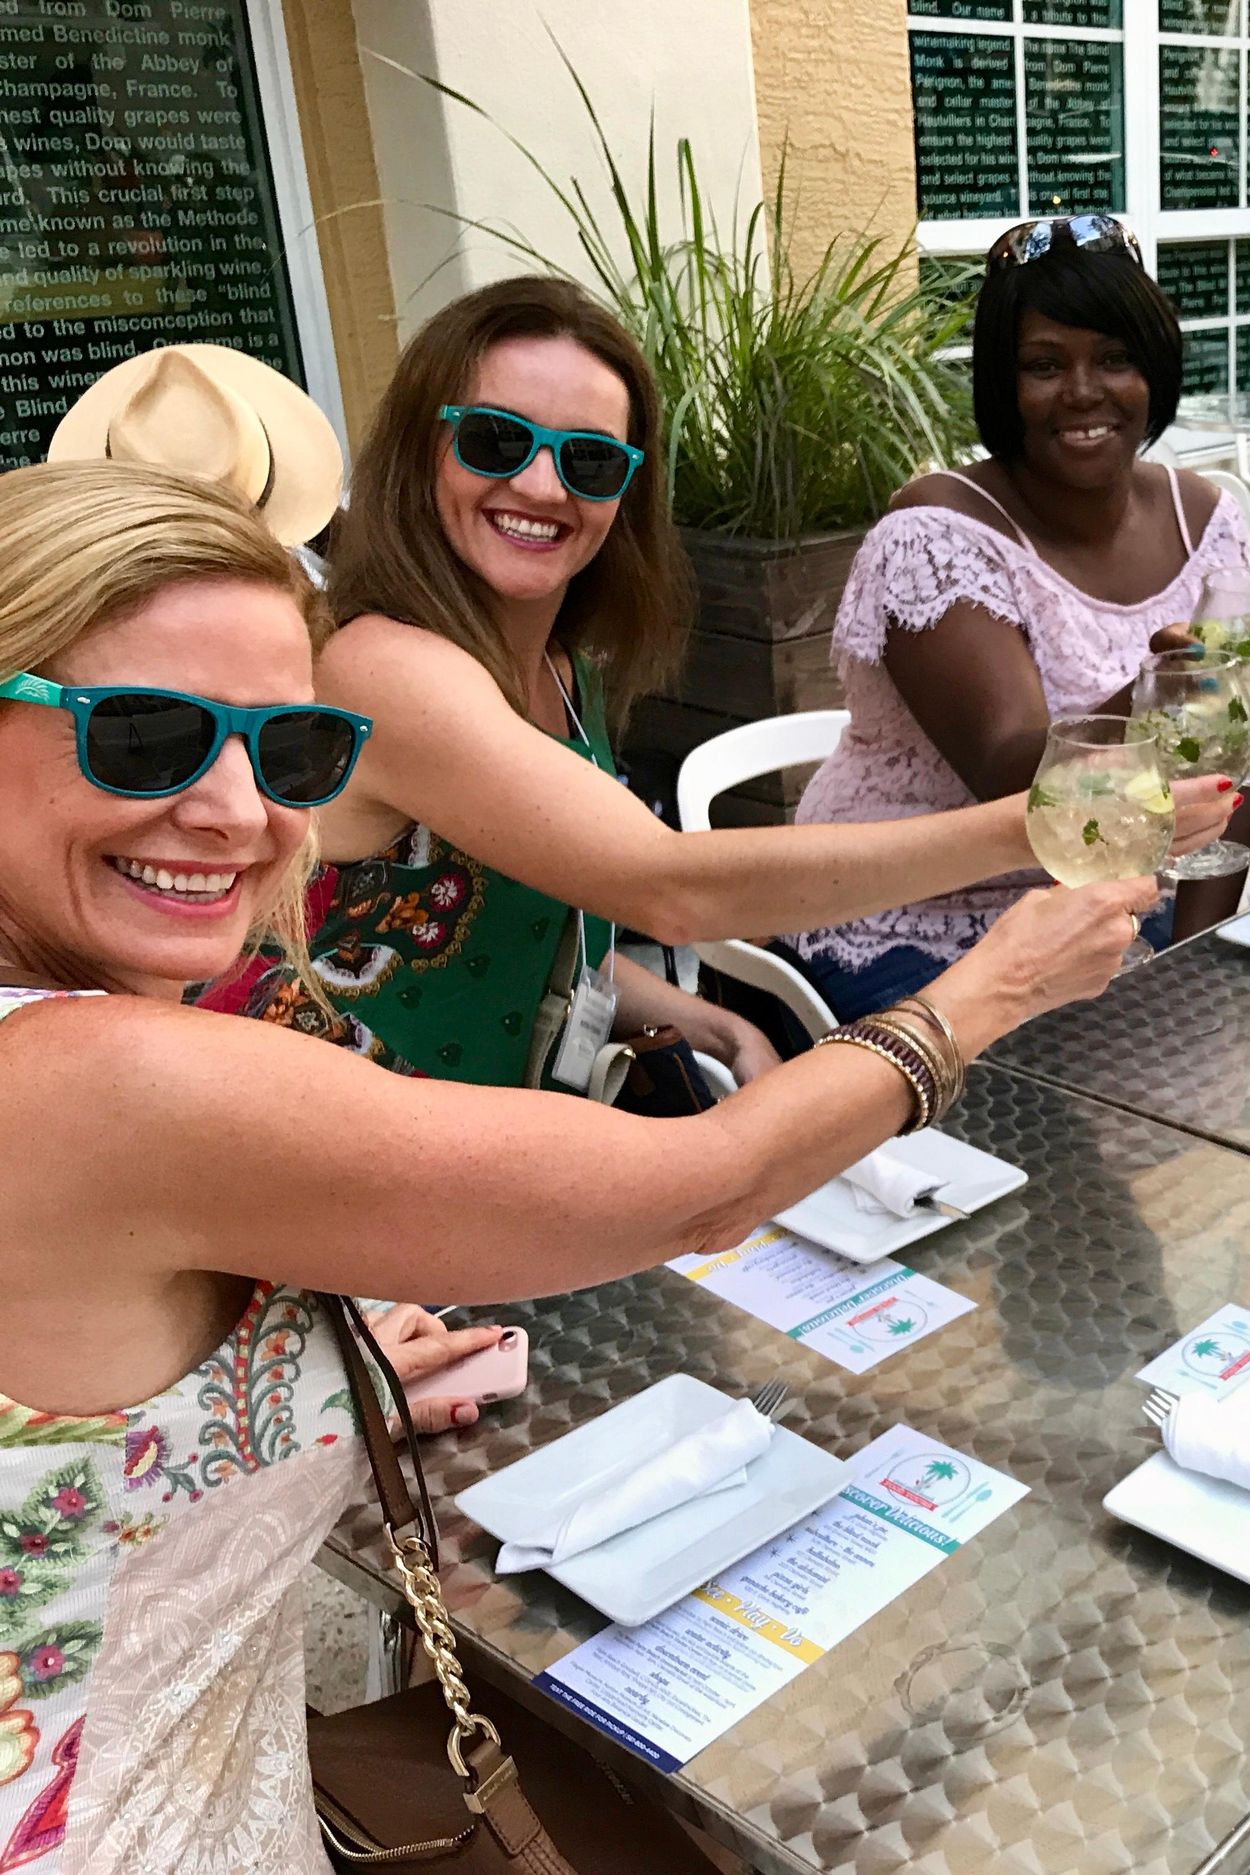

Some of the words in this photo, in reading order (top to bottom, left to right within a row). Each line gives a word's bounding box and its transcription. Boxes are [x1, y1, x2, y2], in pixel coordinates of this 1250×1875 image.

[40, 0, 86, 17] from
[106, 0, 152, 18] Dom
[171, 1, 227, 20] Pierre
[53, 25, 170, 45] Benedictine
[178, 29, 232, 47] monk
[0, 53, 37, 70] ster
[55, 52, 75, 70] of
[93, 53, 126, 71] the
[141, 54, 200, 76] Abbey
[216, 56, 234, 72] of
[126, 79, 198, 99] France.
[216, 81, 239, 99] To
[50, 107, 115, 128] quality
[124, 108, 190, 128] grapes
[197, 109, 242, 125] were
[14, 133, 80, 153] wines,
[85, 132, 131, 151] Dom
[138, 132, 195, 150] would
[200, 134, 247, 151] taste
[51, 159, 127, 178] without
[133, 159, 214, 180] knowing
[220, 160, 250, 177] the
[47, 187, 90, 206] This
[98, 184, 163, 204] crucial
[171, 184, 208, 201] first
[216, 186, 255, 205] step
[39, 213, 105, 234] known
[112, 213, 135, 229] as
[141, 211, 172, 228] the
[178, 209, 259, 227] Methode
[18, 240, 50, 260] led
[59, 239, 80, 258] to
[88, 240, 100, 256] a
[108, 234, 202, 257] revolution
[209, 233, 227, 252] in
[234, 232, 263, 250] the
[33, 265, 100, 289] quality
[105, 262, 125, 282] of
[128, 259, 216, 282] sparkling
[219, 258, 269, 276] wine.
[5, 291, 112, 313] references
[123, 289, 144, 306] to
[155, 286, 208, 305] these
[24, 321, 45, 340] to
[53, 318, 86, 337] the
[94, 309, 234, 335] misconception
[239, 306, 276, 325] that
[42, 346, 89, 365] was
[249, 333, 263, 348] is
[268, 333, 279, 347] a
[2, 373, 40, 393] this
[48, 368, 105, 390] winer
[15, 398, 68, 418] Blind
[842, 1485, 891, 1514] scover
